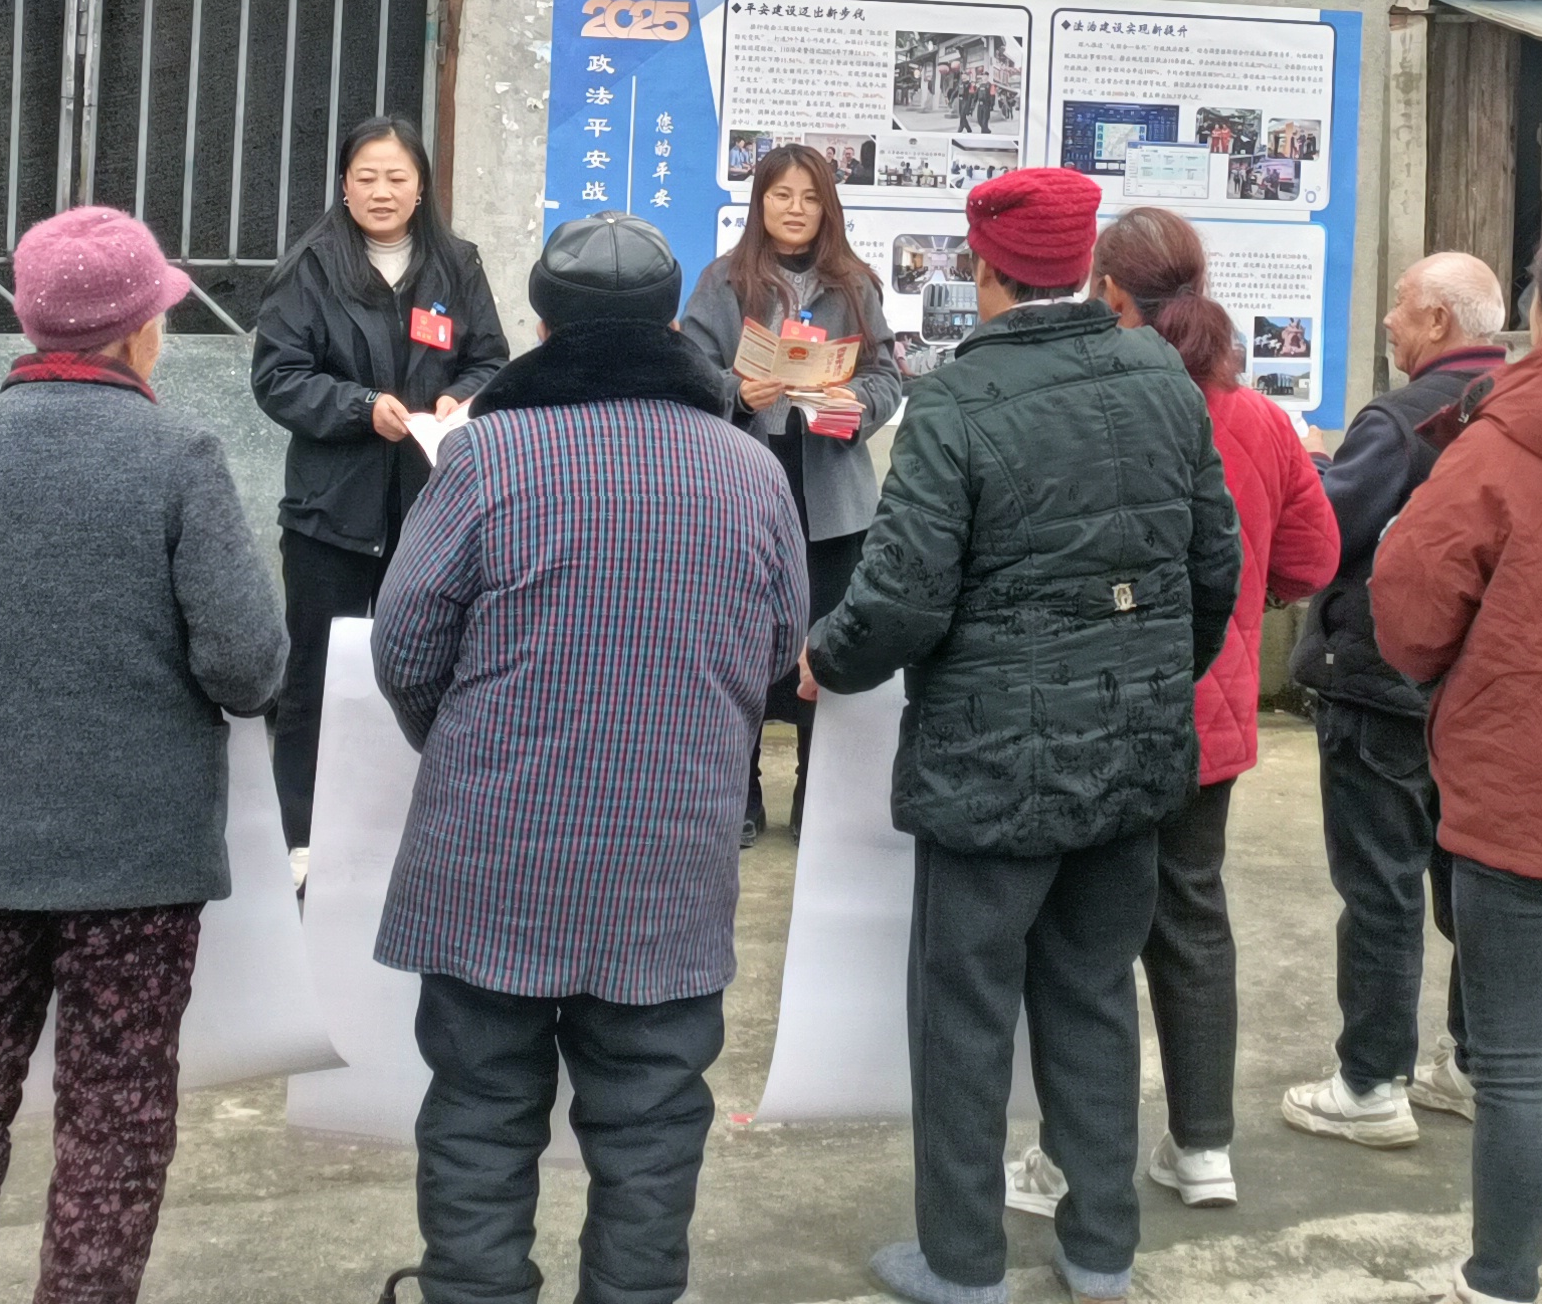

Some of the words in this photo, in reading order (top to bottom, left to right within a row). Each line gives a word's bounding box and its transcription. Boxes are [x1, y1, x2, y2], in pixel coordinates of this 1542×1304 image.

[744, 3, 866, 21] 平安建设迈出新步伐
[1073, 20, 1188, 38] 法治建设实现新提升
[581, 53, 615, 219] 政法平安战
[650, 112, 674, 208] 您的平安
